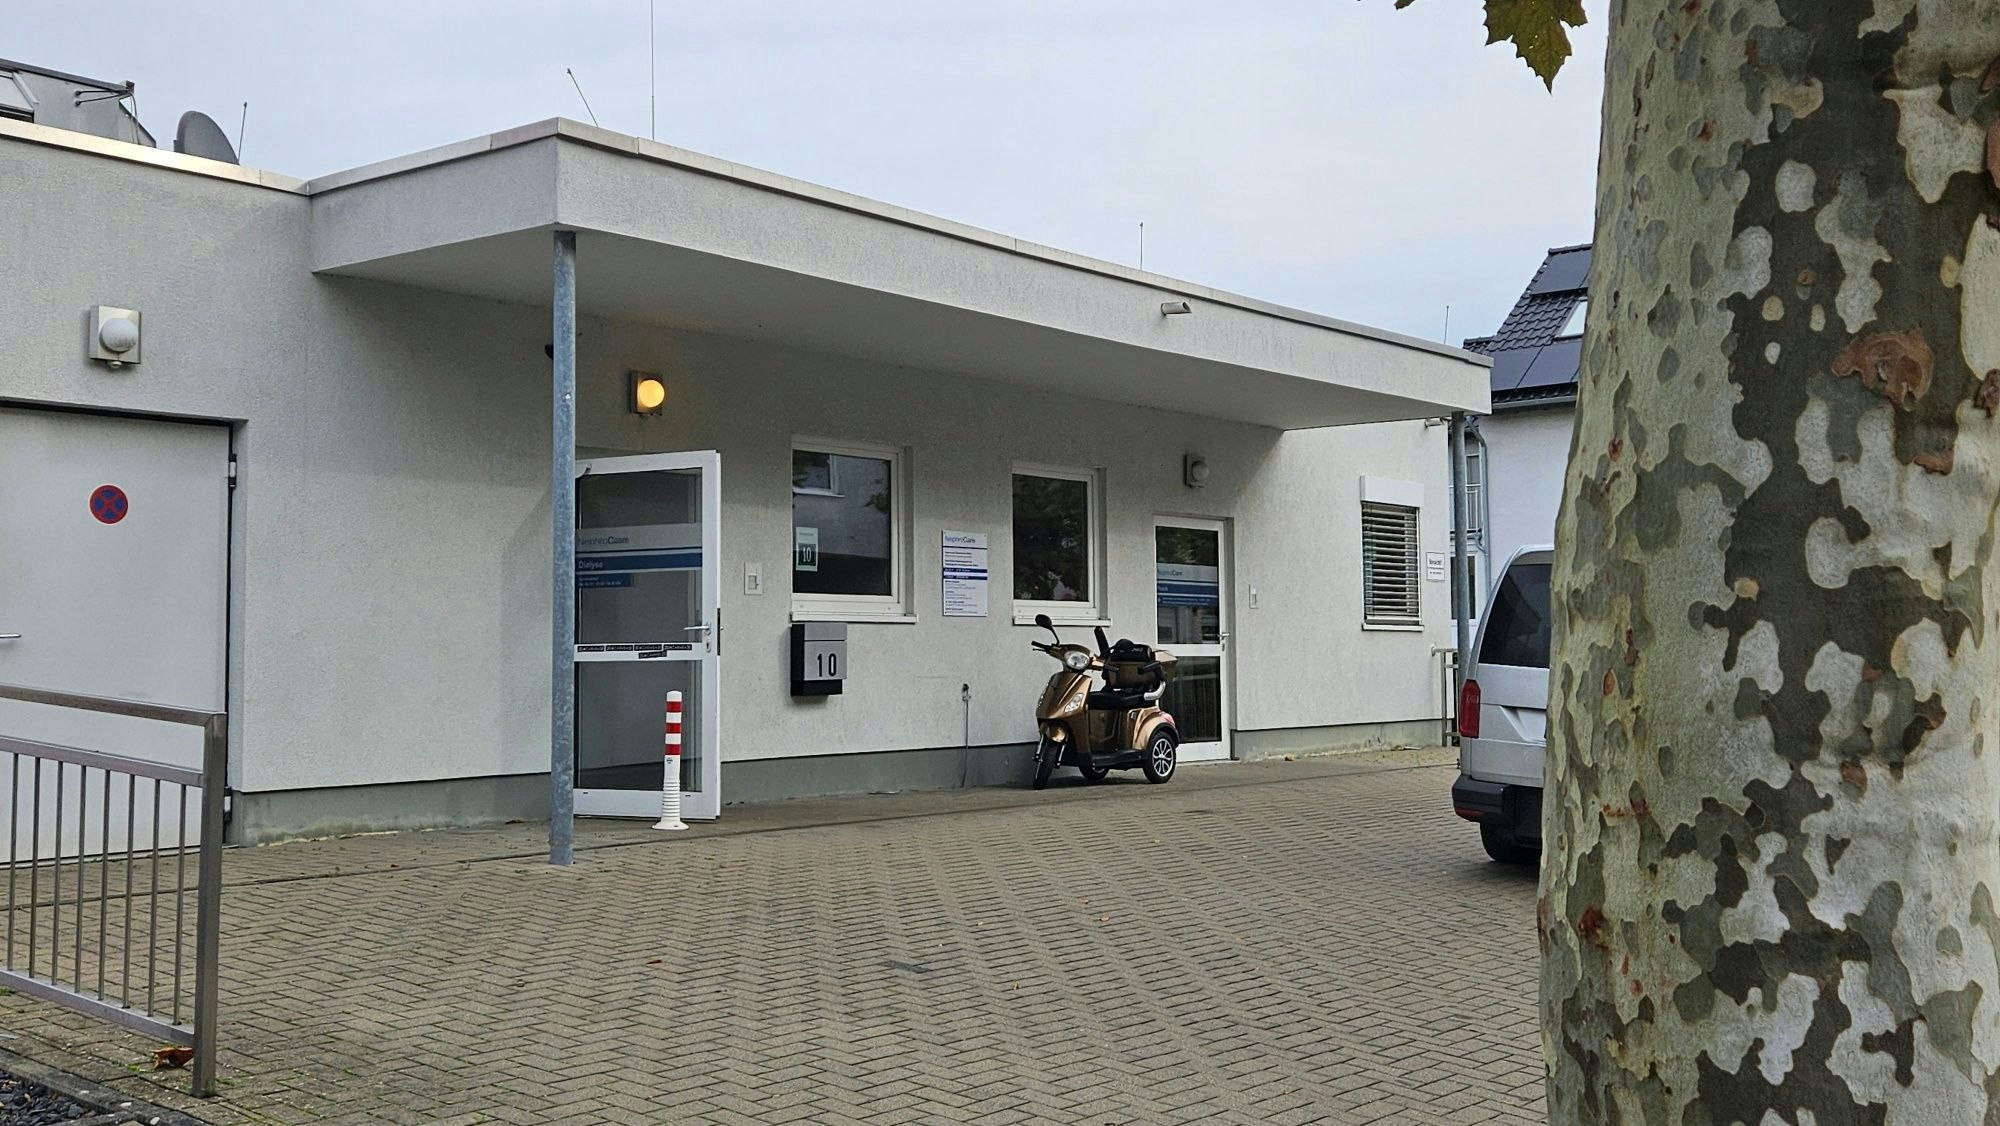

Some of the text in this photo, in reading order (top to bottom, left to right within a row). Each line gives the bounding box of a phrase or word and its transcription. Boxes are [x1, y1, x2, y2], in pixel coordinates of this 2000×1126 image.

[802, 547, 812, 563] 10
[578, 560, 604, 570] Dialyse
[817, 653, 837, 677] 10
